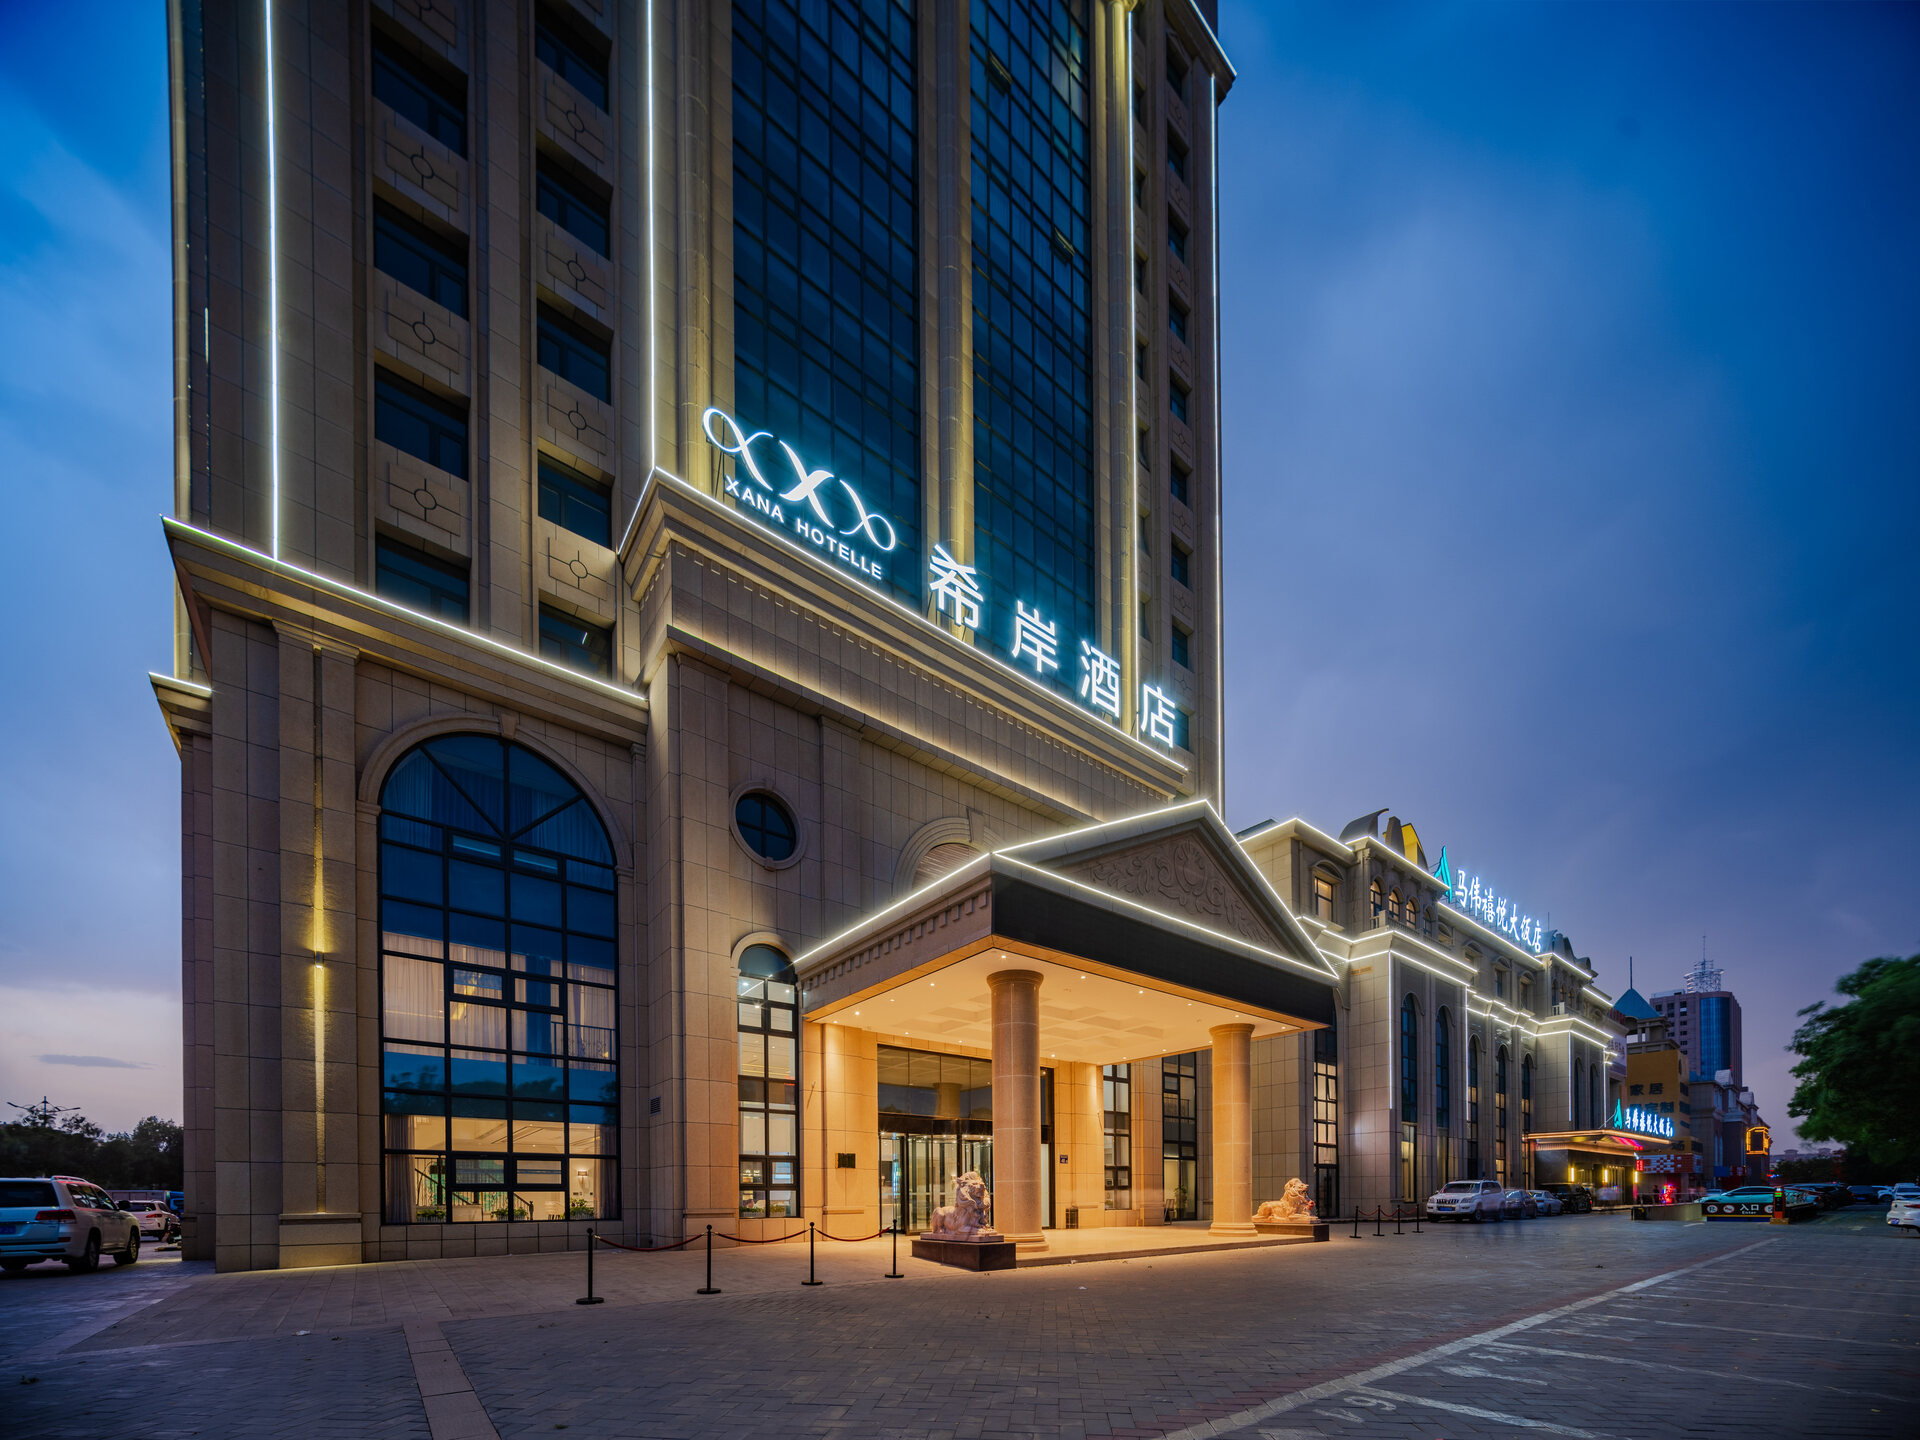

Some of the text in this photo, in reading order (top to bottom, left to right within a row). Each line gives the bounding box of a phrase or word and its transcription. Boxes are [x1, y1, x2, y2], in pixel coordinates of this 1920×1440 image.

[725, 474, 883, 581] XANA HOTELLE
[928, 543, 1176, 749] 希岸酒店
[1739, 1203, 1759, 1211] 入口
